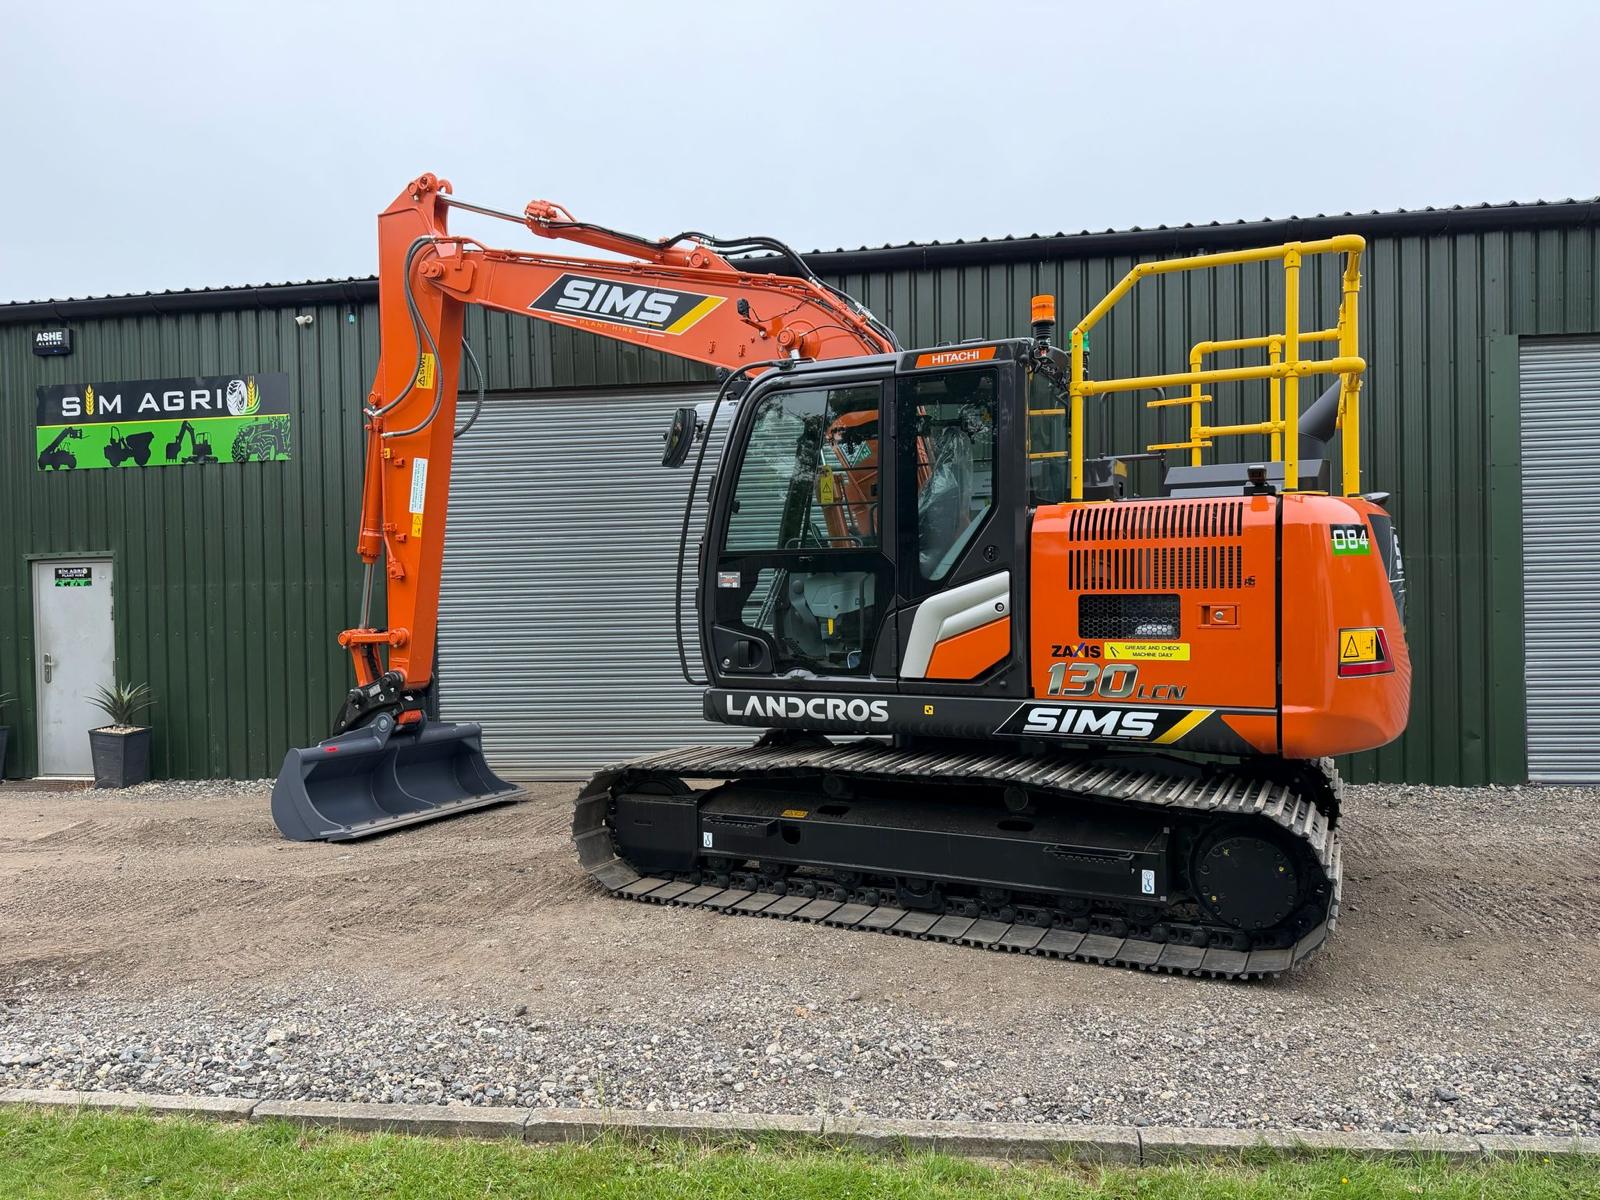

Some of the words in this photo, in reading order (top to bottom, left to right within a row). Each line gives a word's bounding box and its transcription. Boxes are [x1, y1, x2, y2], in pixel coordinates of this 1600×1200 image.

[557, 280, 679, 322] SIMS
[36, 331, 63, 342] ASHE
[579, 320, 609, 329] PLANT
[612, 324, 634, 334] HIRE
[931, 350, 980, 364] HITACHI
[1333, 529, 1369, 550] 084
[1051, 643, 1101, 658] ZAXIS
[1047, 662, 1139, 698] 130
[1136, 684, 1187, 700] LCN
[726, 694, 889, 722] LANDCROS
[1023, 707, 1159, 737] SIMS
